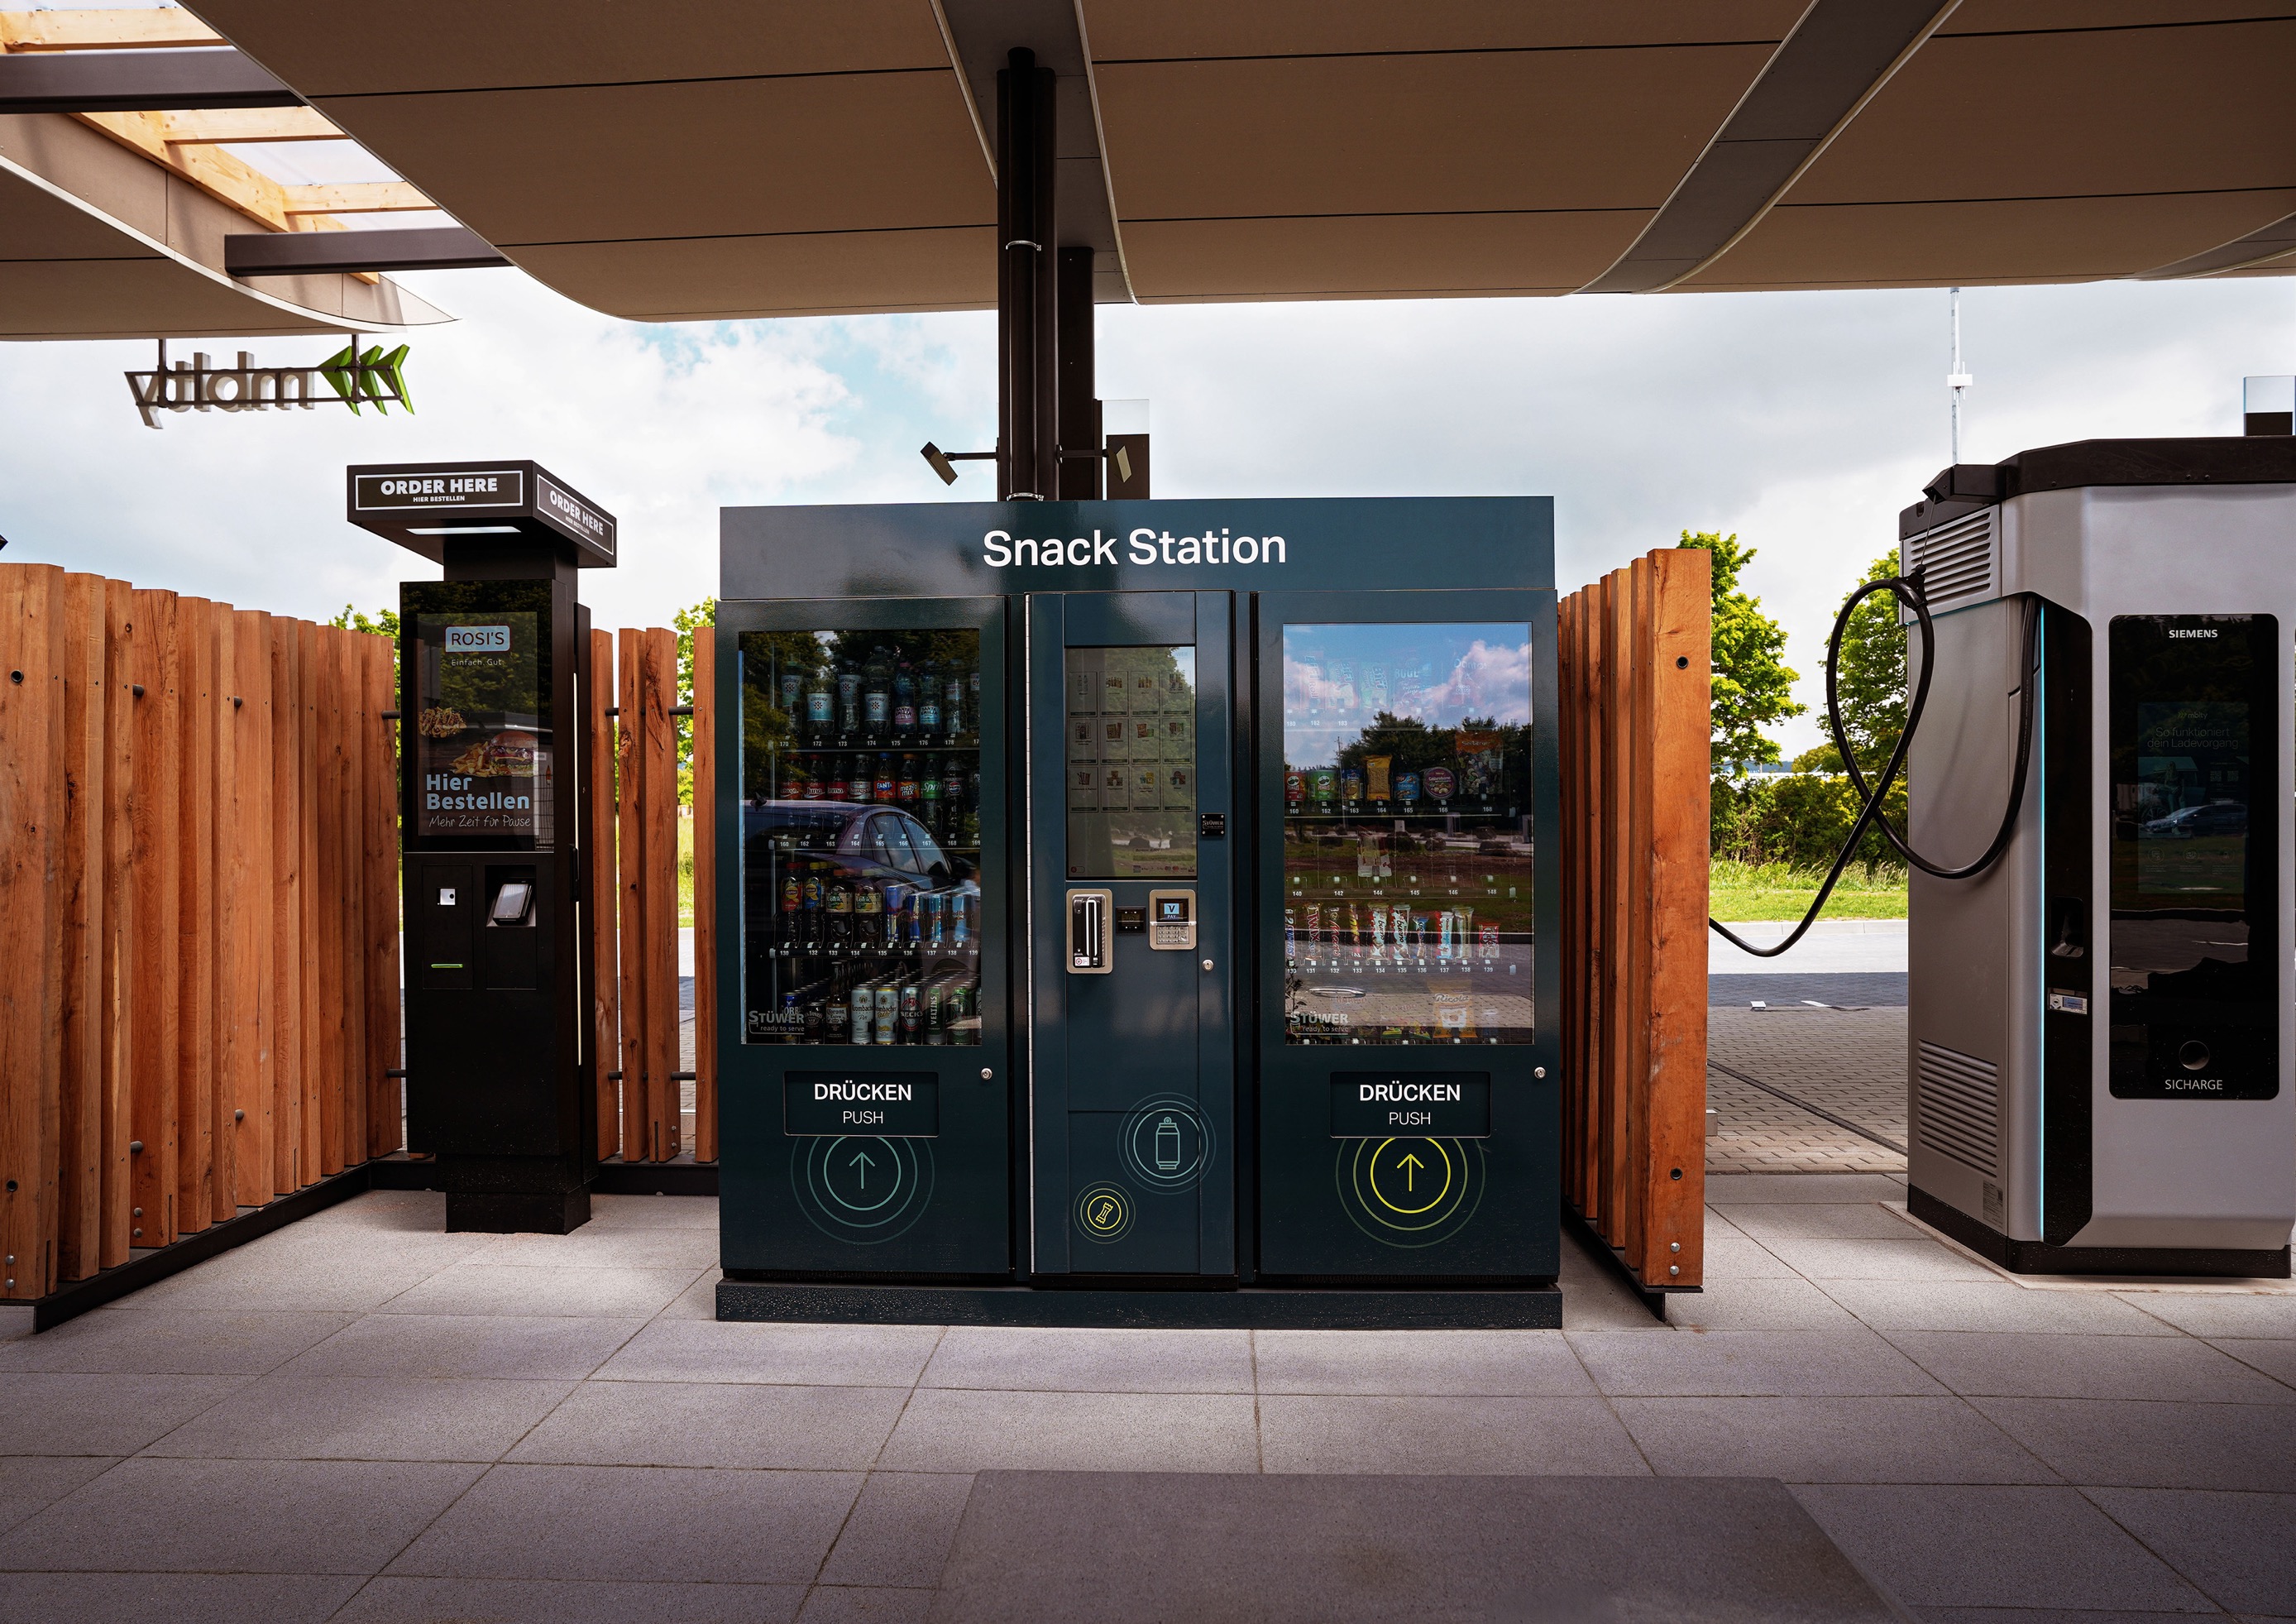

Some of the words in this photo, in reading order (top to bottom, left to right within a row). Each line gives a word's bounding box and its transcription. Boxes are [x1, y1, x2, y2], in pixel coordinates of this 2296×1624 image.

[380, 479, 445, 496] ORDER
[450, 477, 498, 493] HERE
[550, 491, 581, 521] ORDER
[582, 510, 604, 536] HERE
[983, 529, 1118, 568] Snack
[1128, 528, 1286, 565] Station
[452, 632, 505, 645] ROSI'S
[2168, 629, 2218, 639] SIEMENS
[2155, 726, 2170, 736] So
[2172, 726, 2230, 736] funktioniert
[2147, 738, 2169, 748] dein
[2171, 738, 2239, 750] Ladevorgang
[426, 774, 472, 791] Hier
[427, 792, 529, 810] Bestellen
[428, 815, 456, 827] Mehr
[458, 814, 480, 827] Zeit
[484, 815, 500, 826] für
[502, 814, 531, 826] Pause
[1167, 904, 1175, 913] V
[1307, 911, 1320, 941] TWIX
[1434, 993, 1469, 1004] Ricola
[875, 1005, 897, 1013] rombacher
[749, 1010, 805, 1023] STÜWER
[1290, 1012, 1349, 1025] STÜWER
[814, 1080, 912, 1101] DRÜCKEN
[1359, 1080, 1461, 1101] DRÜCKEN
[2164, 1079, 2223, 1090] SICHARGE
[843, 1111, 883, 1124] PUSH
[1389, 1112, 1431, 1125] PUSH
